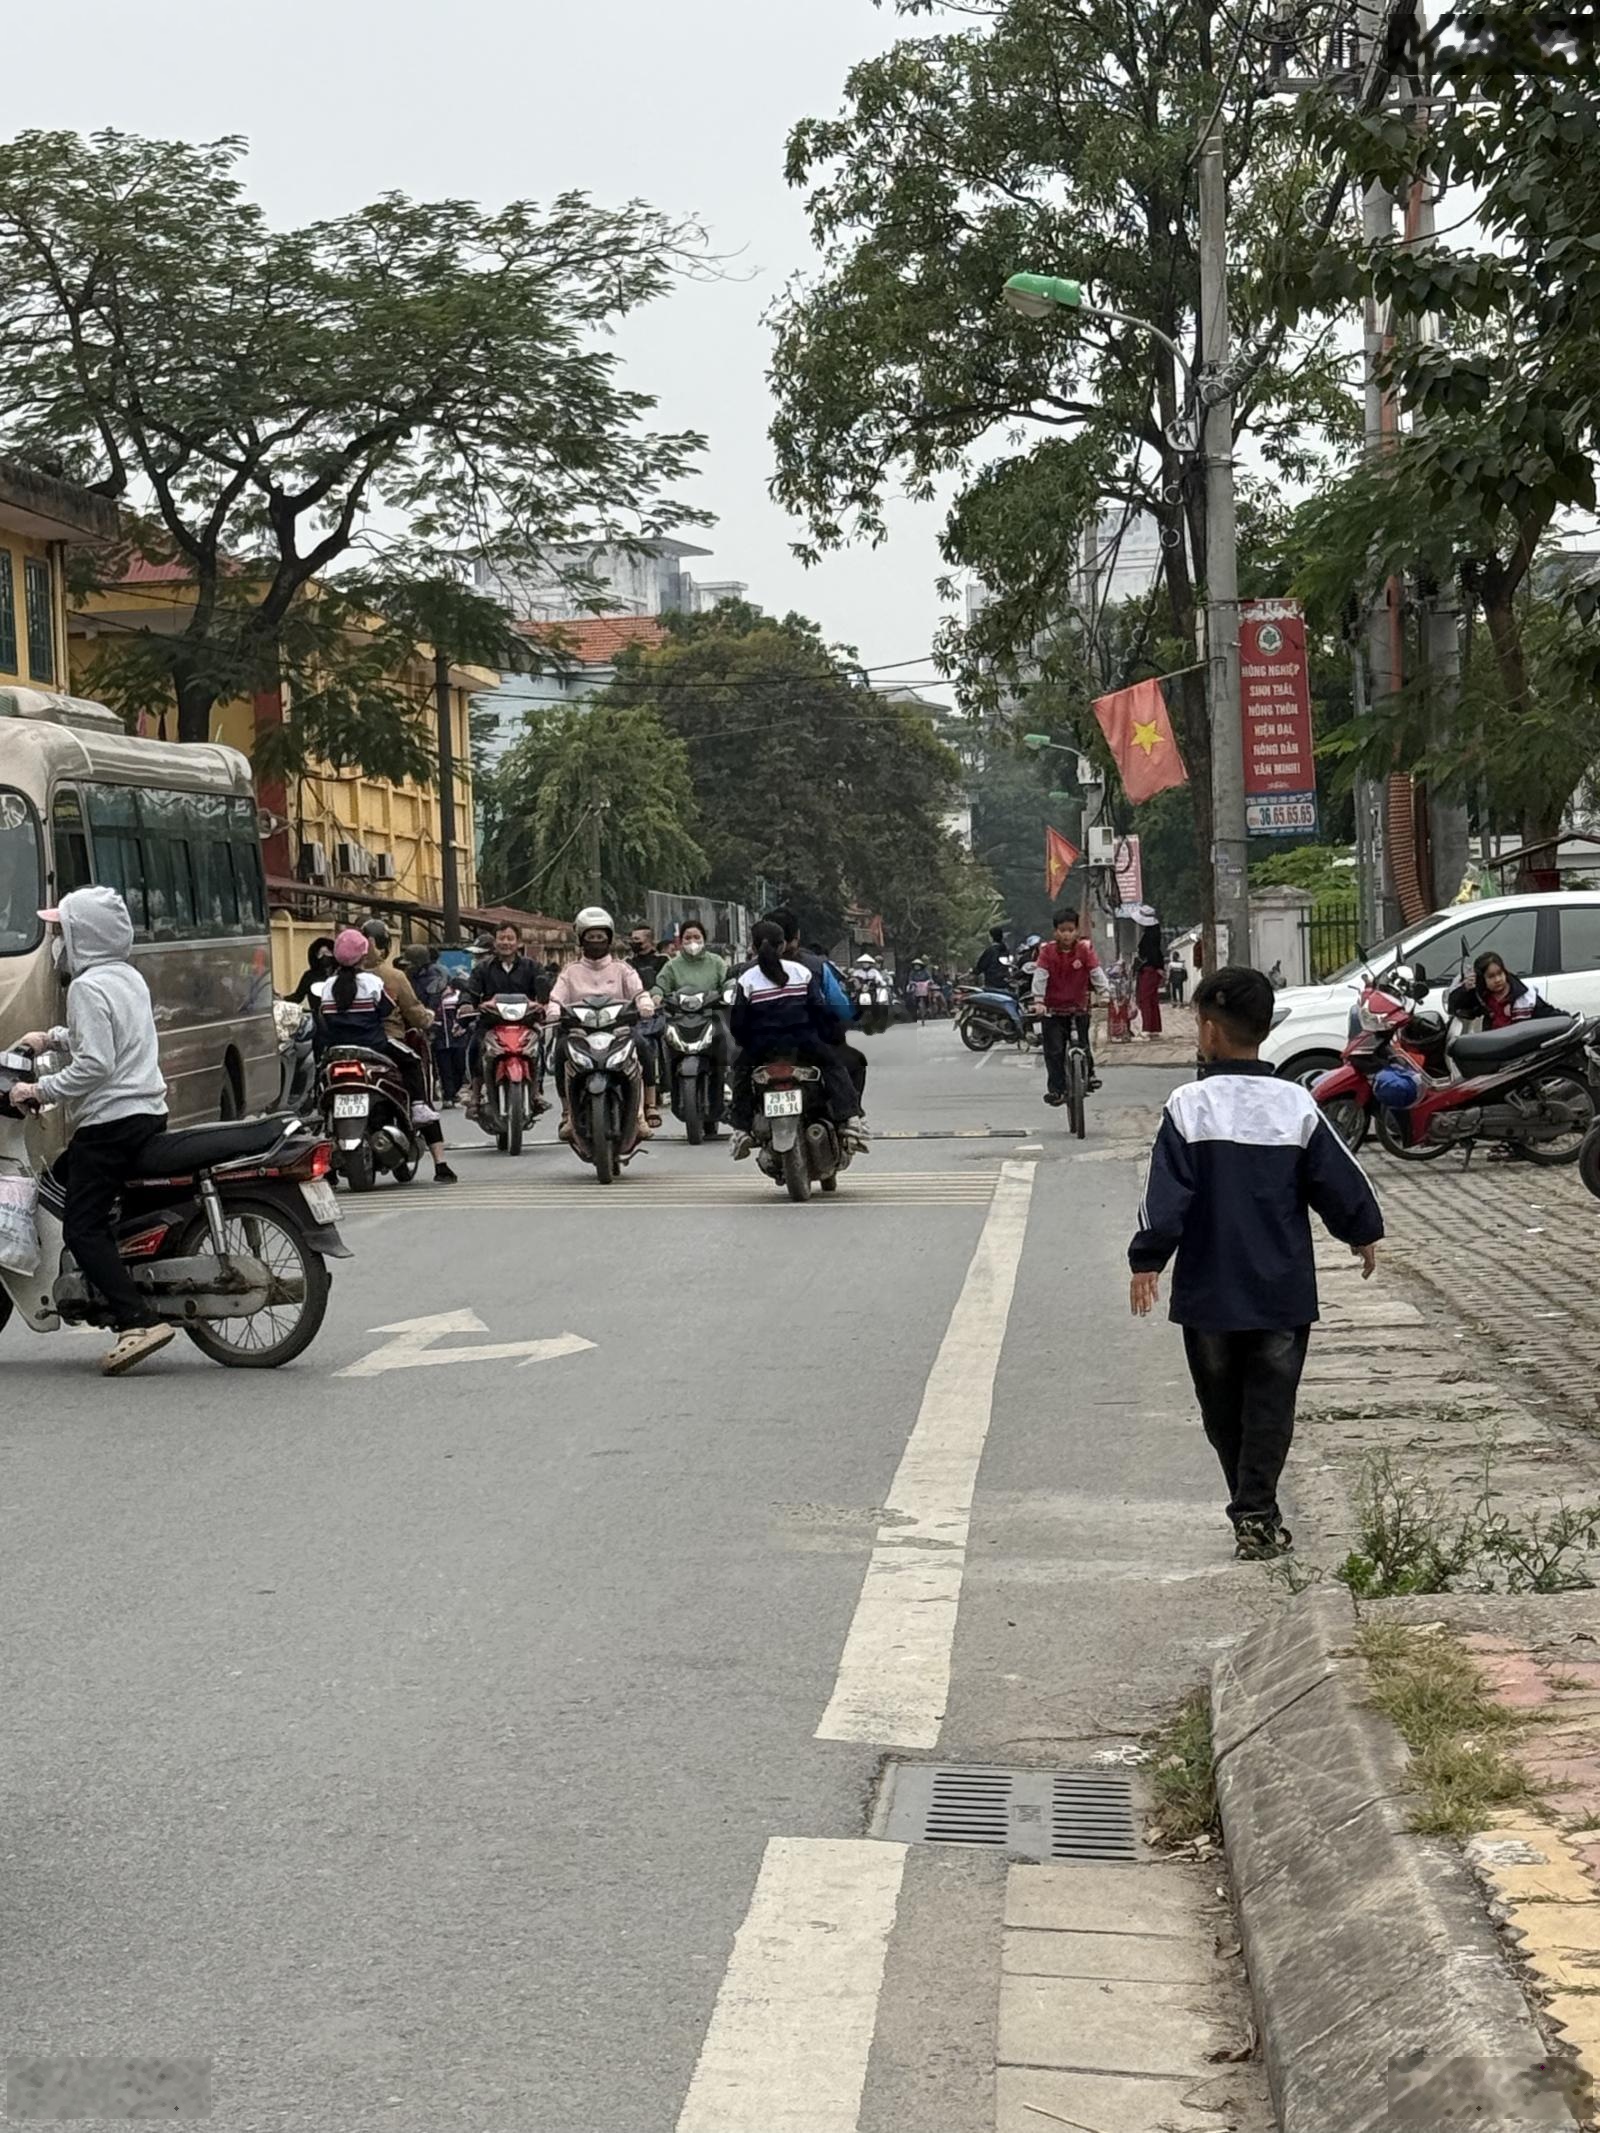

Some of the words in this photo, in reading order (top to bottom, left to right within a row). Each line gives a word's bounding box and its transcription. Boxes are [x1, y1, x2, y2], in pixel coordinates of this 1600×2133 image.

[1249, 685, 1271, 696] SINH
[1248, 703, 1273, 716] NÔNG
[1274, 702, 1298, 715] THÔN
[1254, 722, 1275, 738] HIỆN
[1253, 743, 1278, 756] NÔNG
